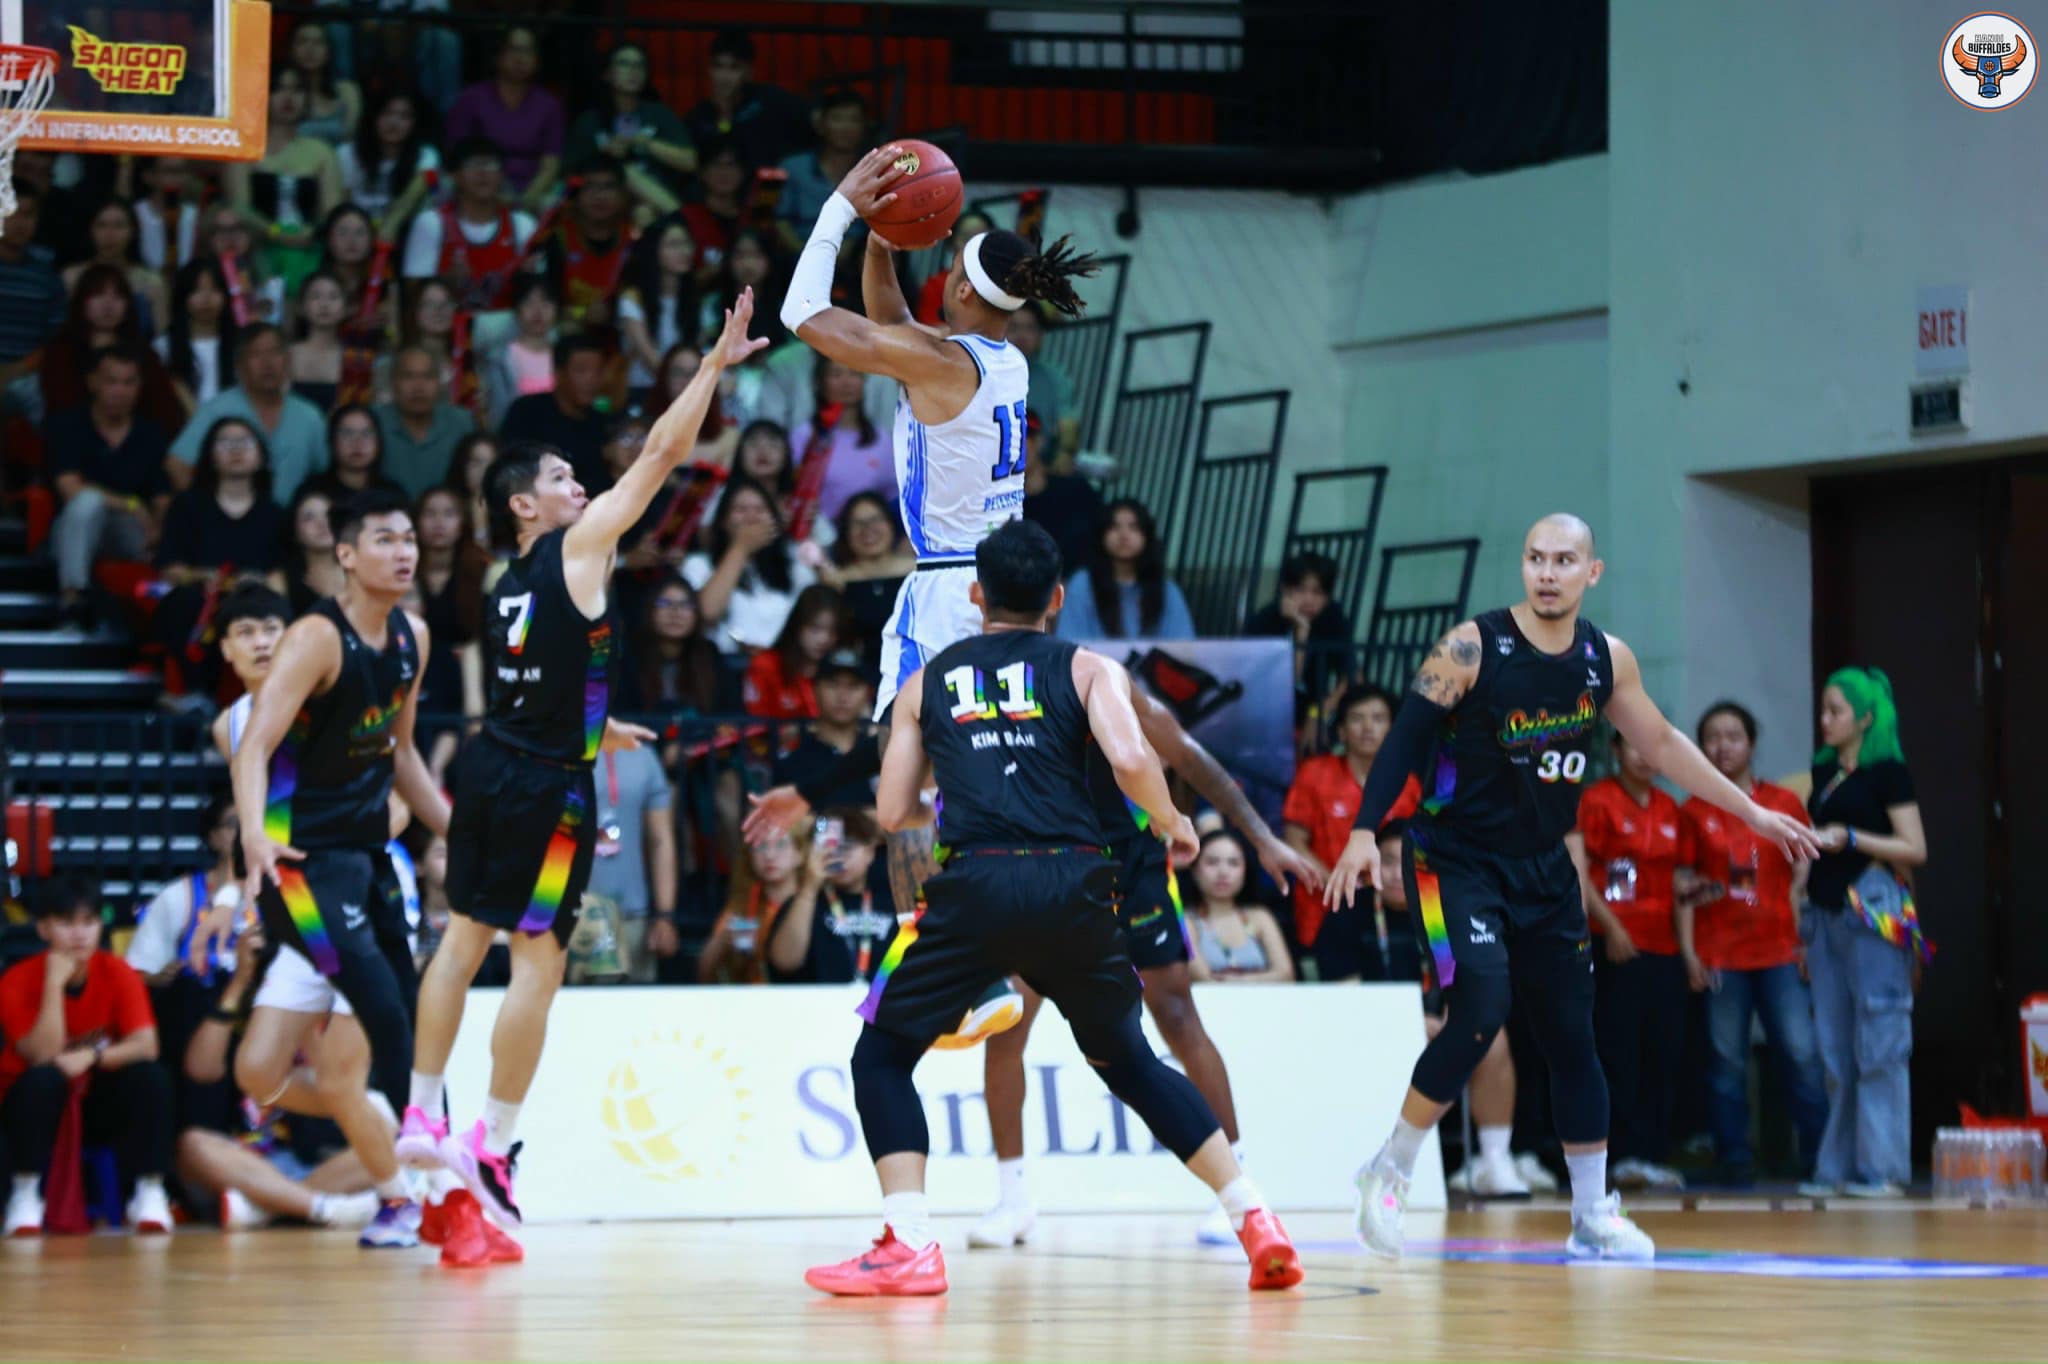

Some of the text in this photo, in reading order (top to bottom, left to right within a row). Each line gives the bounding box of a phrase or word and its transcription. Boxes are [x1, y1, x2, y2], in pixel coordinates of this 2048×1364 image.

[78, 45, 183, 70] SAIGON
[103, 70, 180, 92] HEAT
[48, 121, 173, 144] INTERNATIONAL
[176, 126, 241, 147] SCHOOL
[1919, 309, 1956, 350] GATE
[498, 591, 537, 656] 7
[944, 661, 1044, 725] 11
[971, 730, 1000, 751] KIM
[1537, 749, 1586, 784] 30
